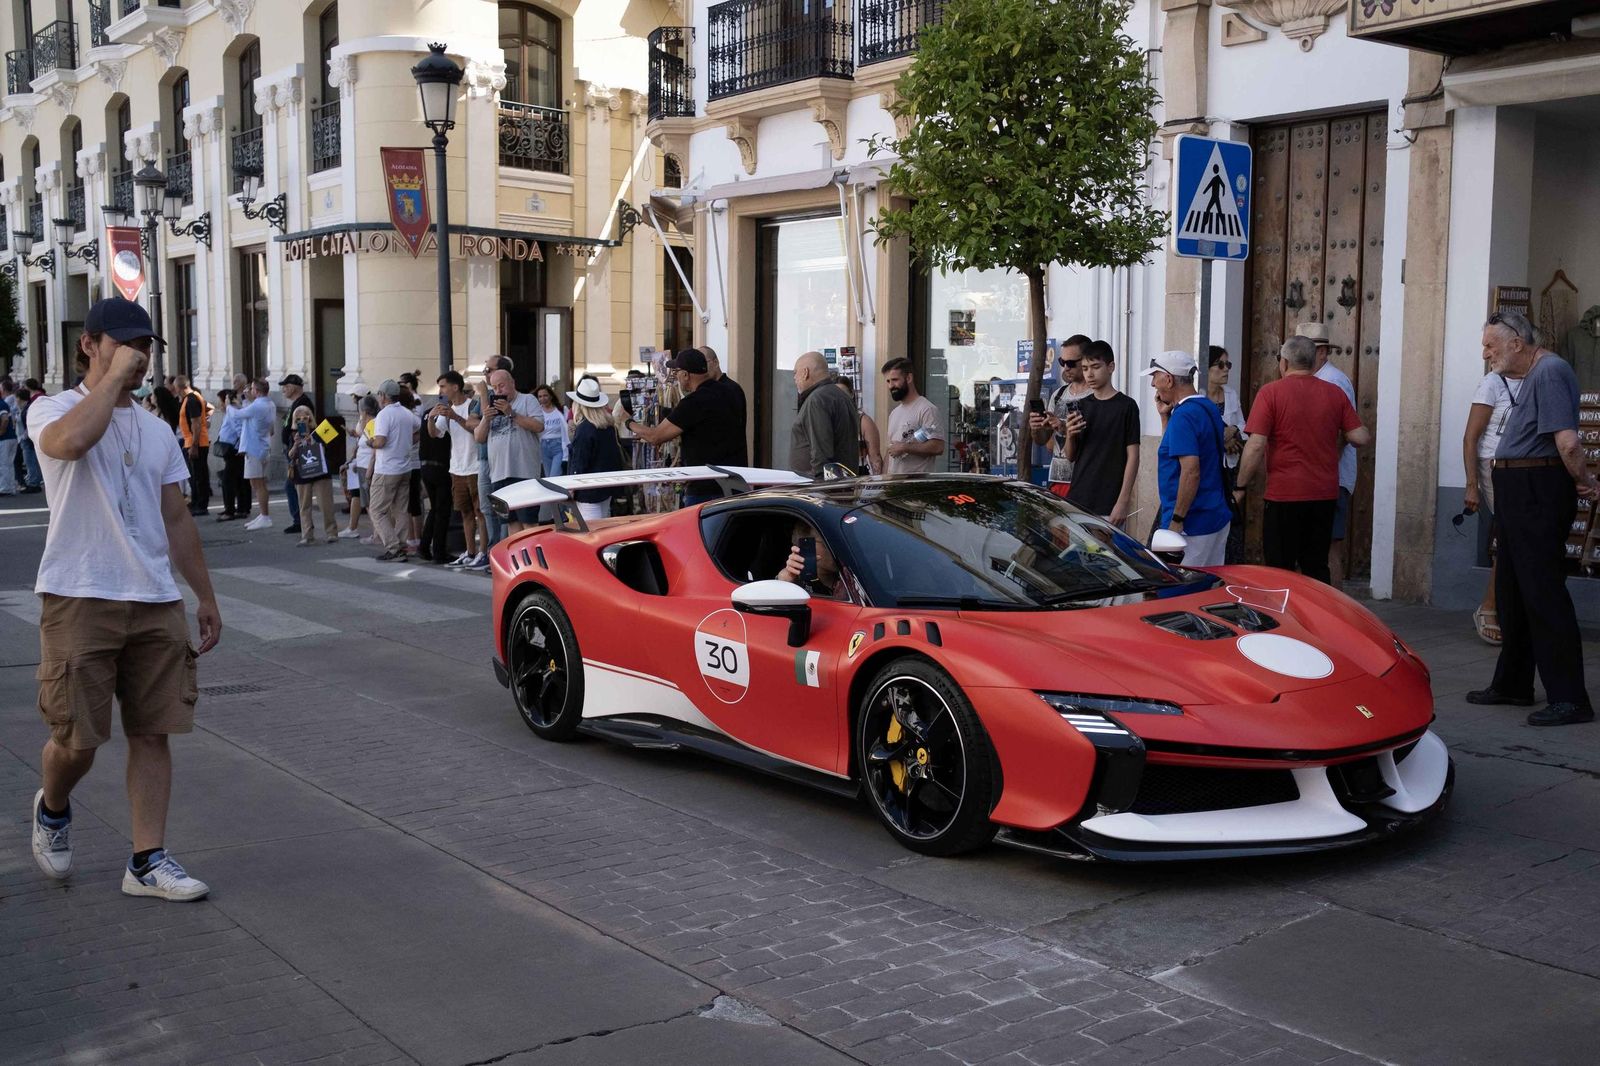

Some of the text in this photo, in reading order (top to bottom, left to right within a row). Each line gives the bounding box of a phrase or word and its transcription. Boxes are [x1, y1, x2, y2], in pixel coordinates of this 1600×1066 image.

[285, 231, 544, 262] HOTEL CATALONA RONDA
[947, 494, 976, 505] 30
[705, 640, 738, 675] 30
